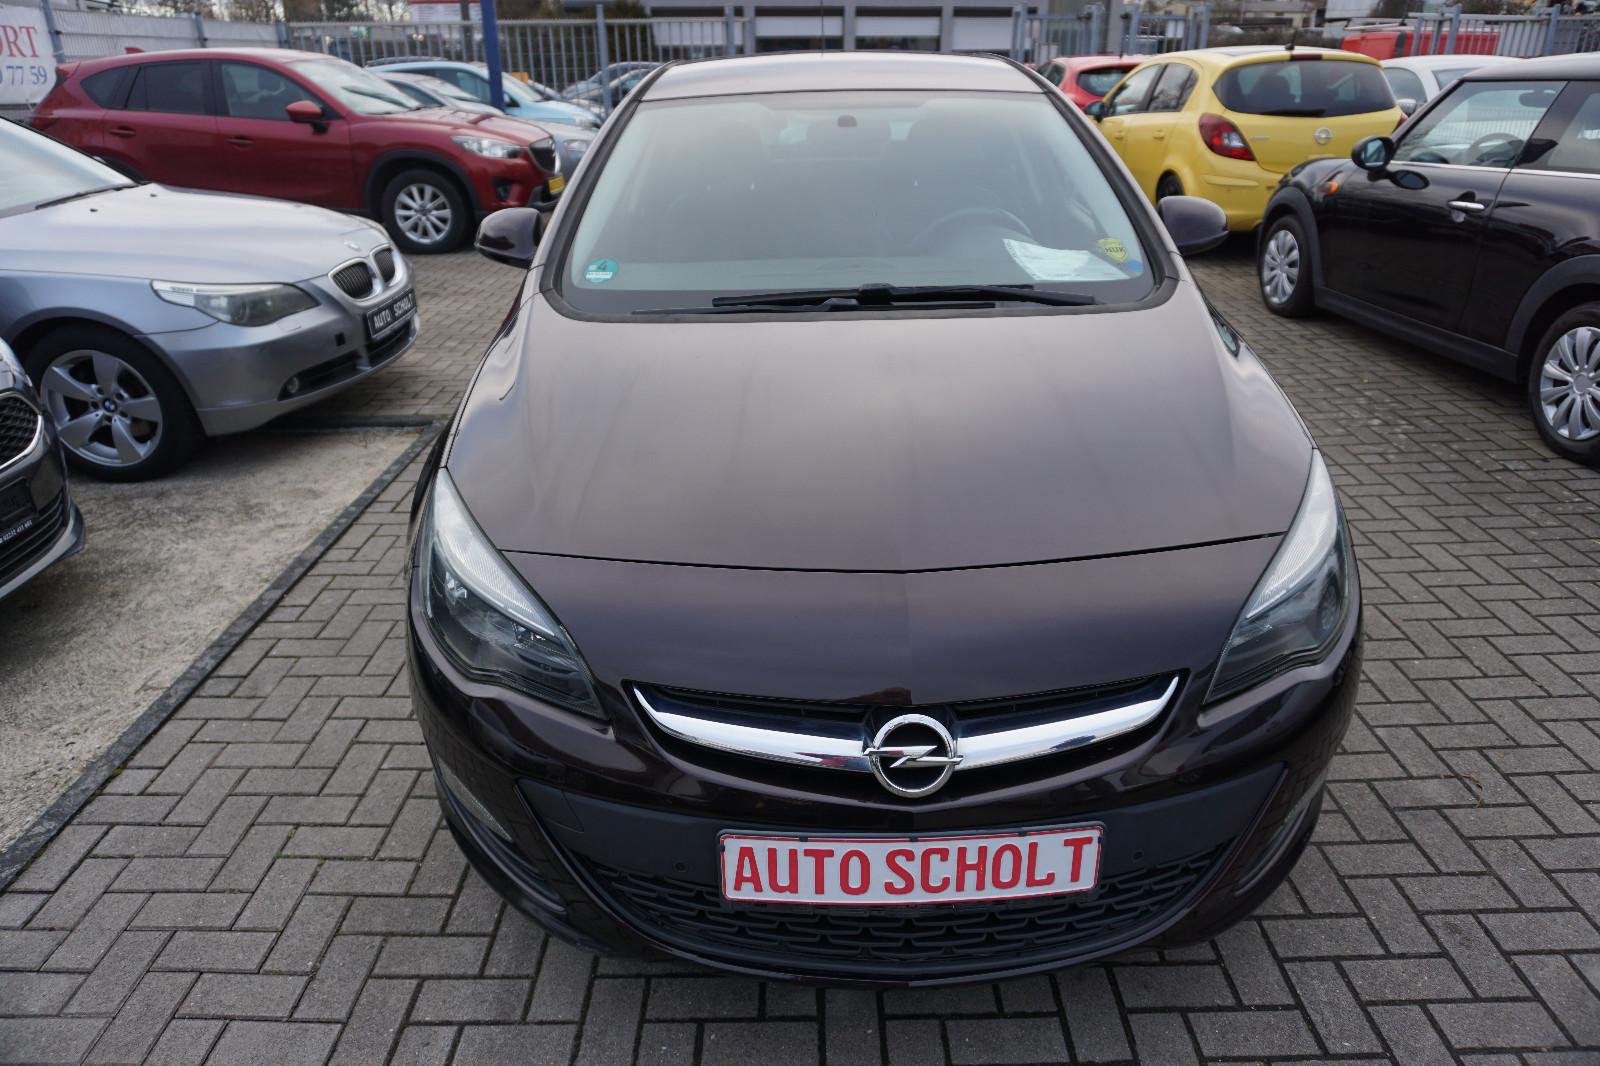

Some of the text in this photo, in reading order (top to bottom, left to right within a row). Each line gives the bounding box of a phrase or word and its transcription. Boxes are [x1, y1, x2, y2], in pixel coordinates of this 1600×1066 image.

[0, 25, 40, 57] RT
[6, 65, 24, 86] 77
[30, 65, 48, 85] 59
[373, 293, 413, 329] AUTO SCHOLT
[733, 836, 1094, 896] AUTO SCHOLT
